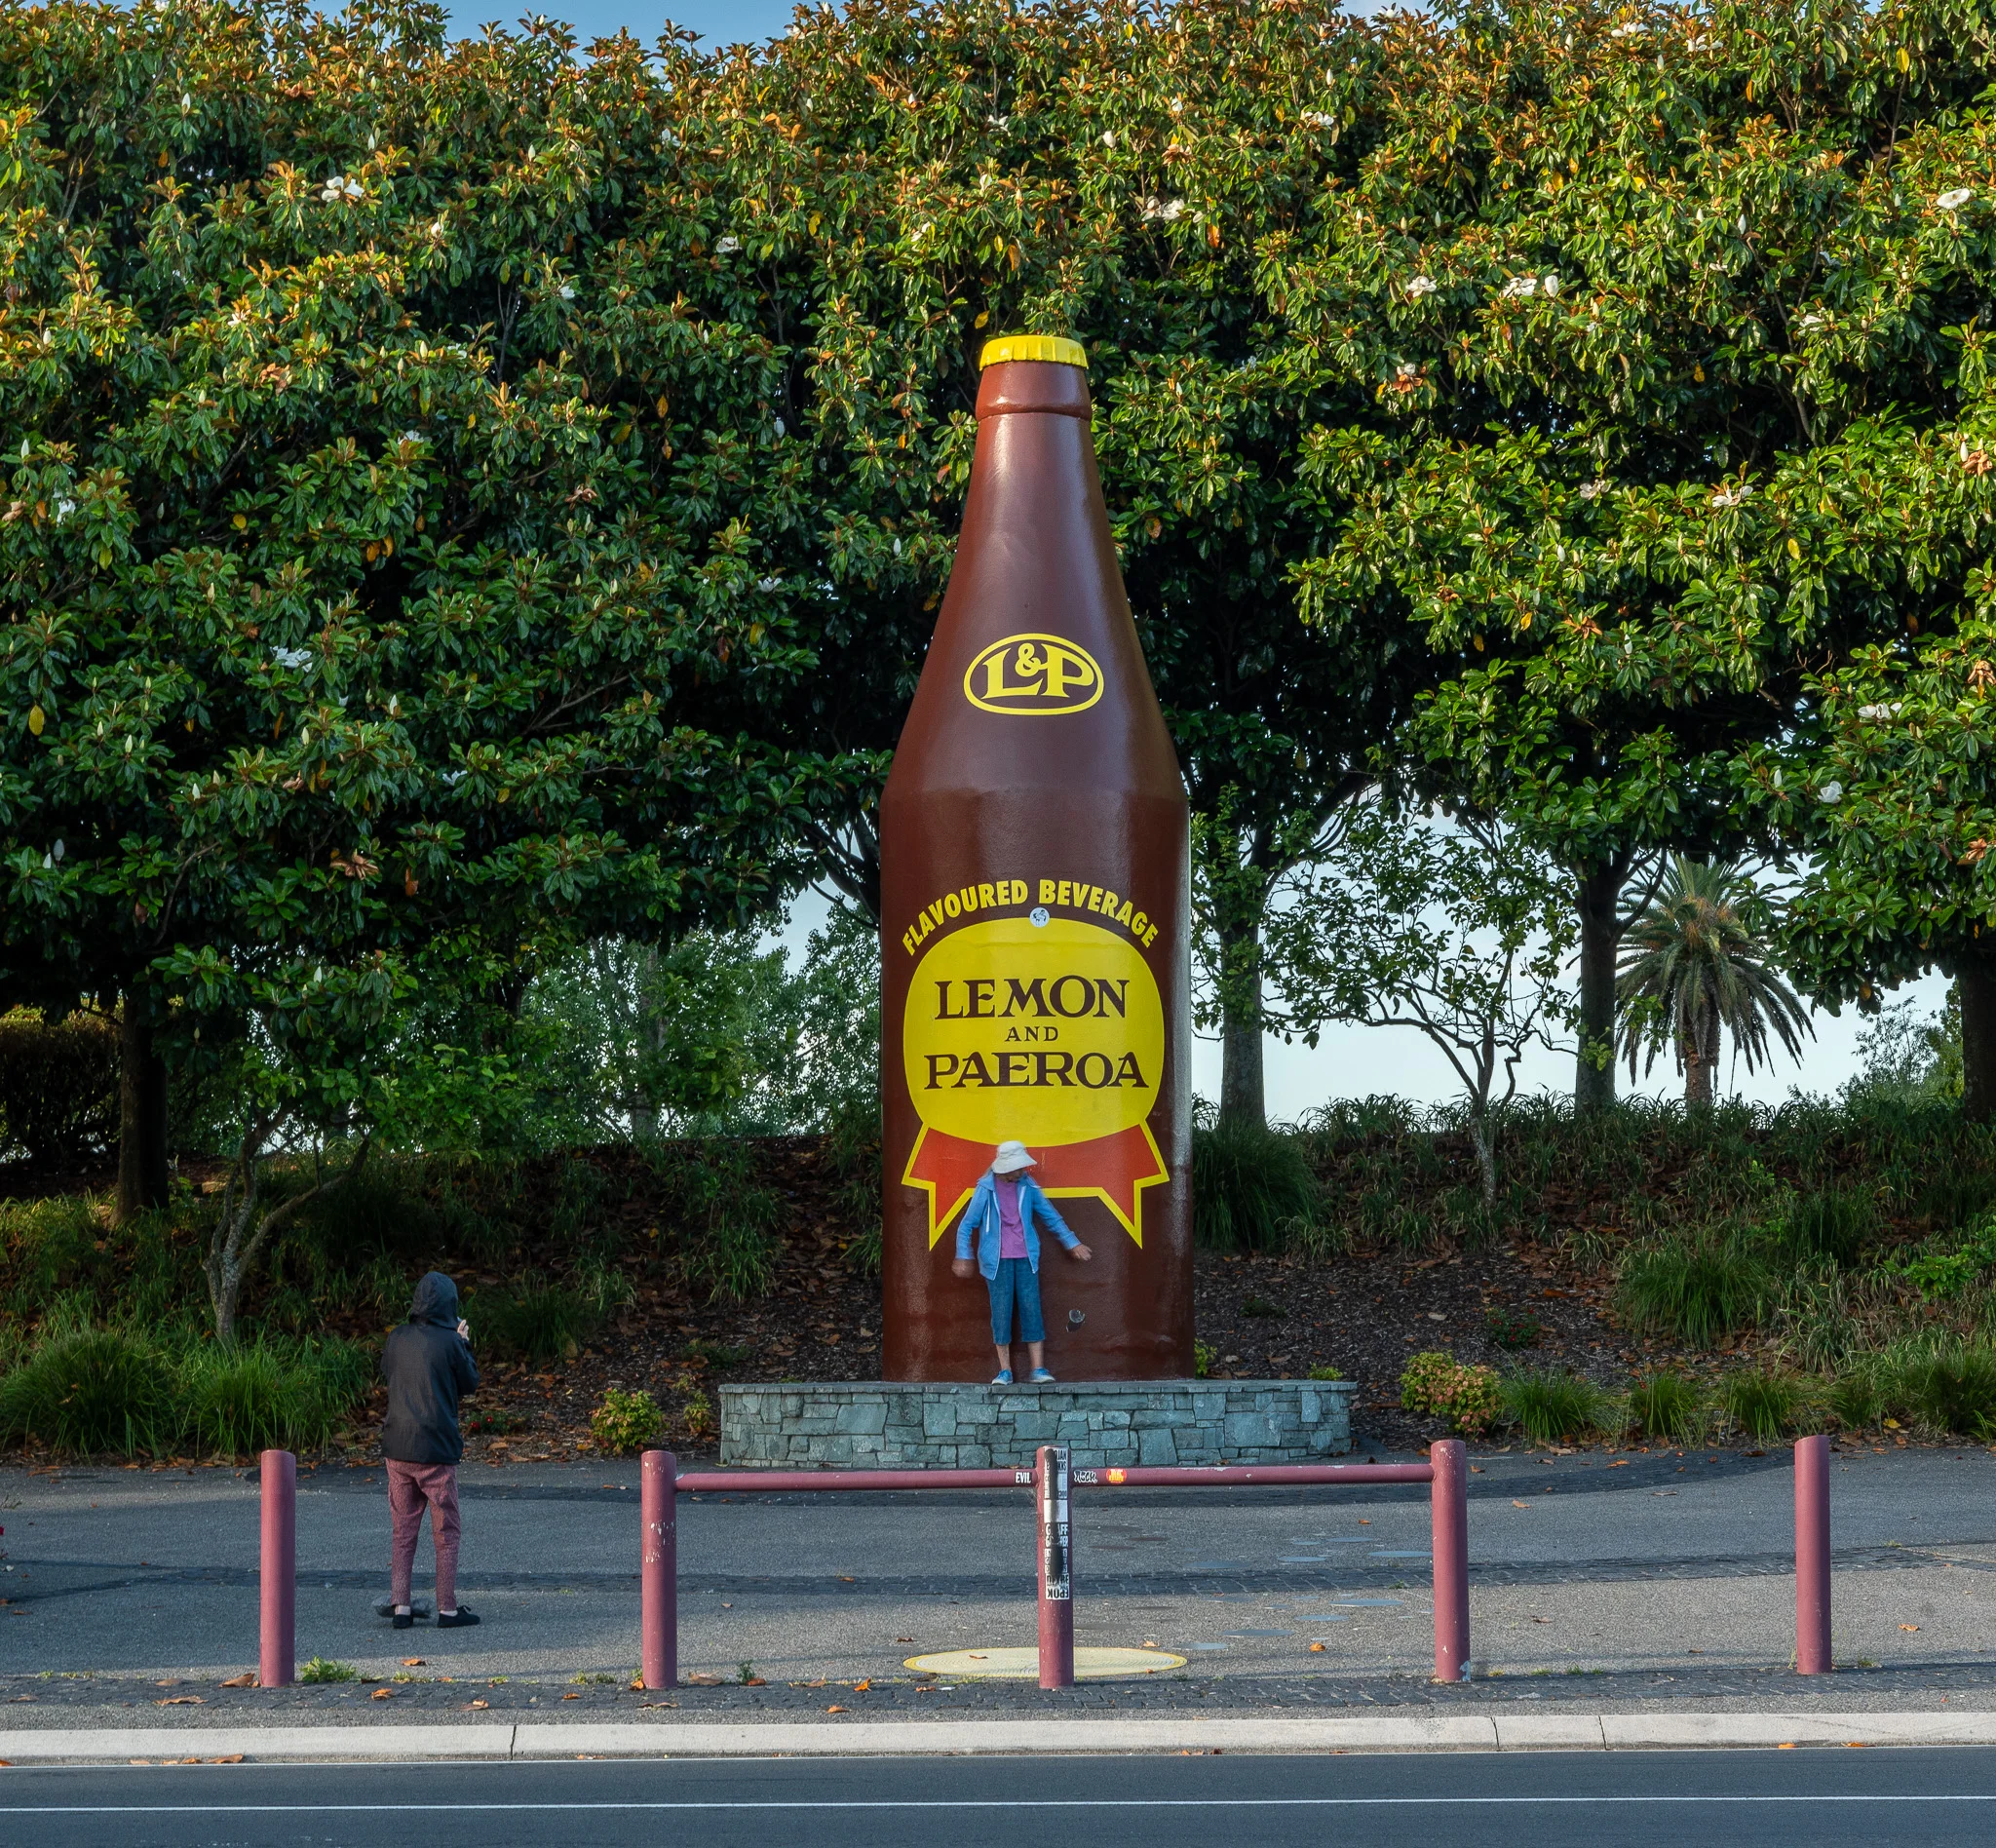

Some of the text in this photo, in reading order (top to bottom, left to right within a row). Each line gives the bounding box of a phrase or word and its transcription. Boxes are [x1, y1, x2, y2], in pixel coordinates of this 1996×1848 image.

[980, 642, 1094, 700] L&P
[902, 879, 1159, 956] FLAVOURED BEVERAGE
[935, 975, 1131, 1020] LEMON
[1004, 1025, 1059, 1042] AND
[924, 1051, 1150, 1090] PAEROA
[1015, 1472, 1032, 1483] EVIL
